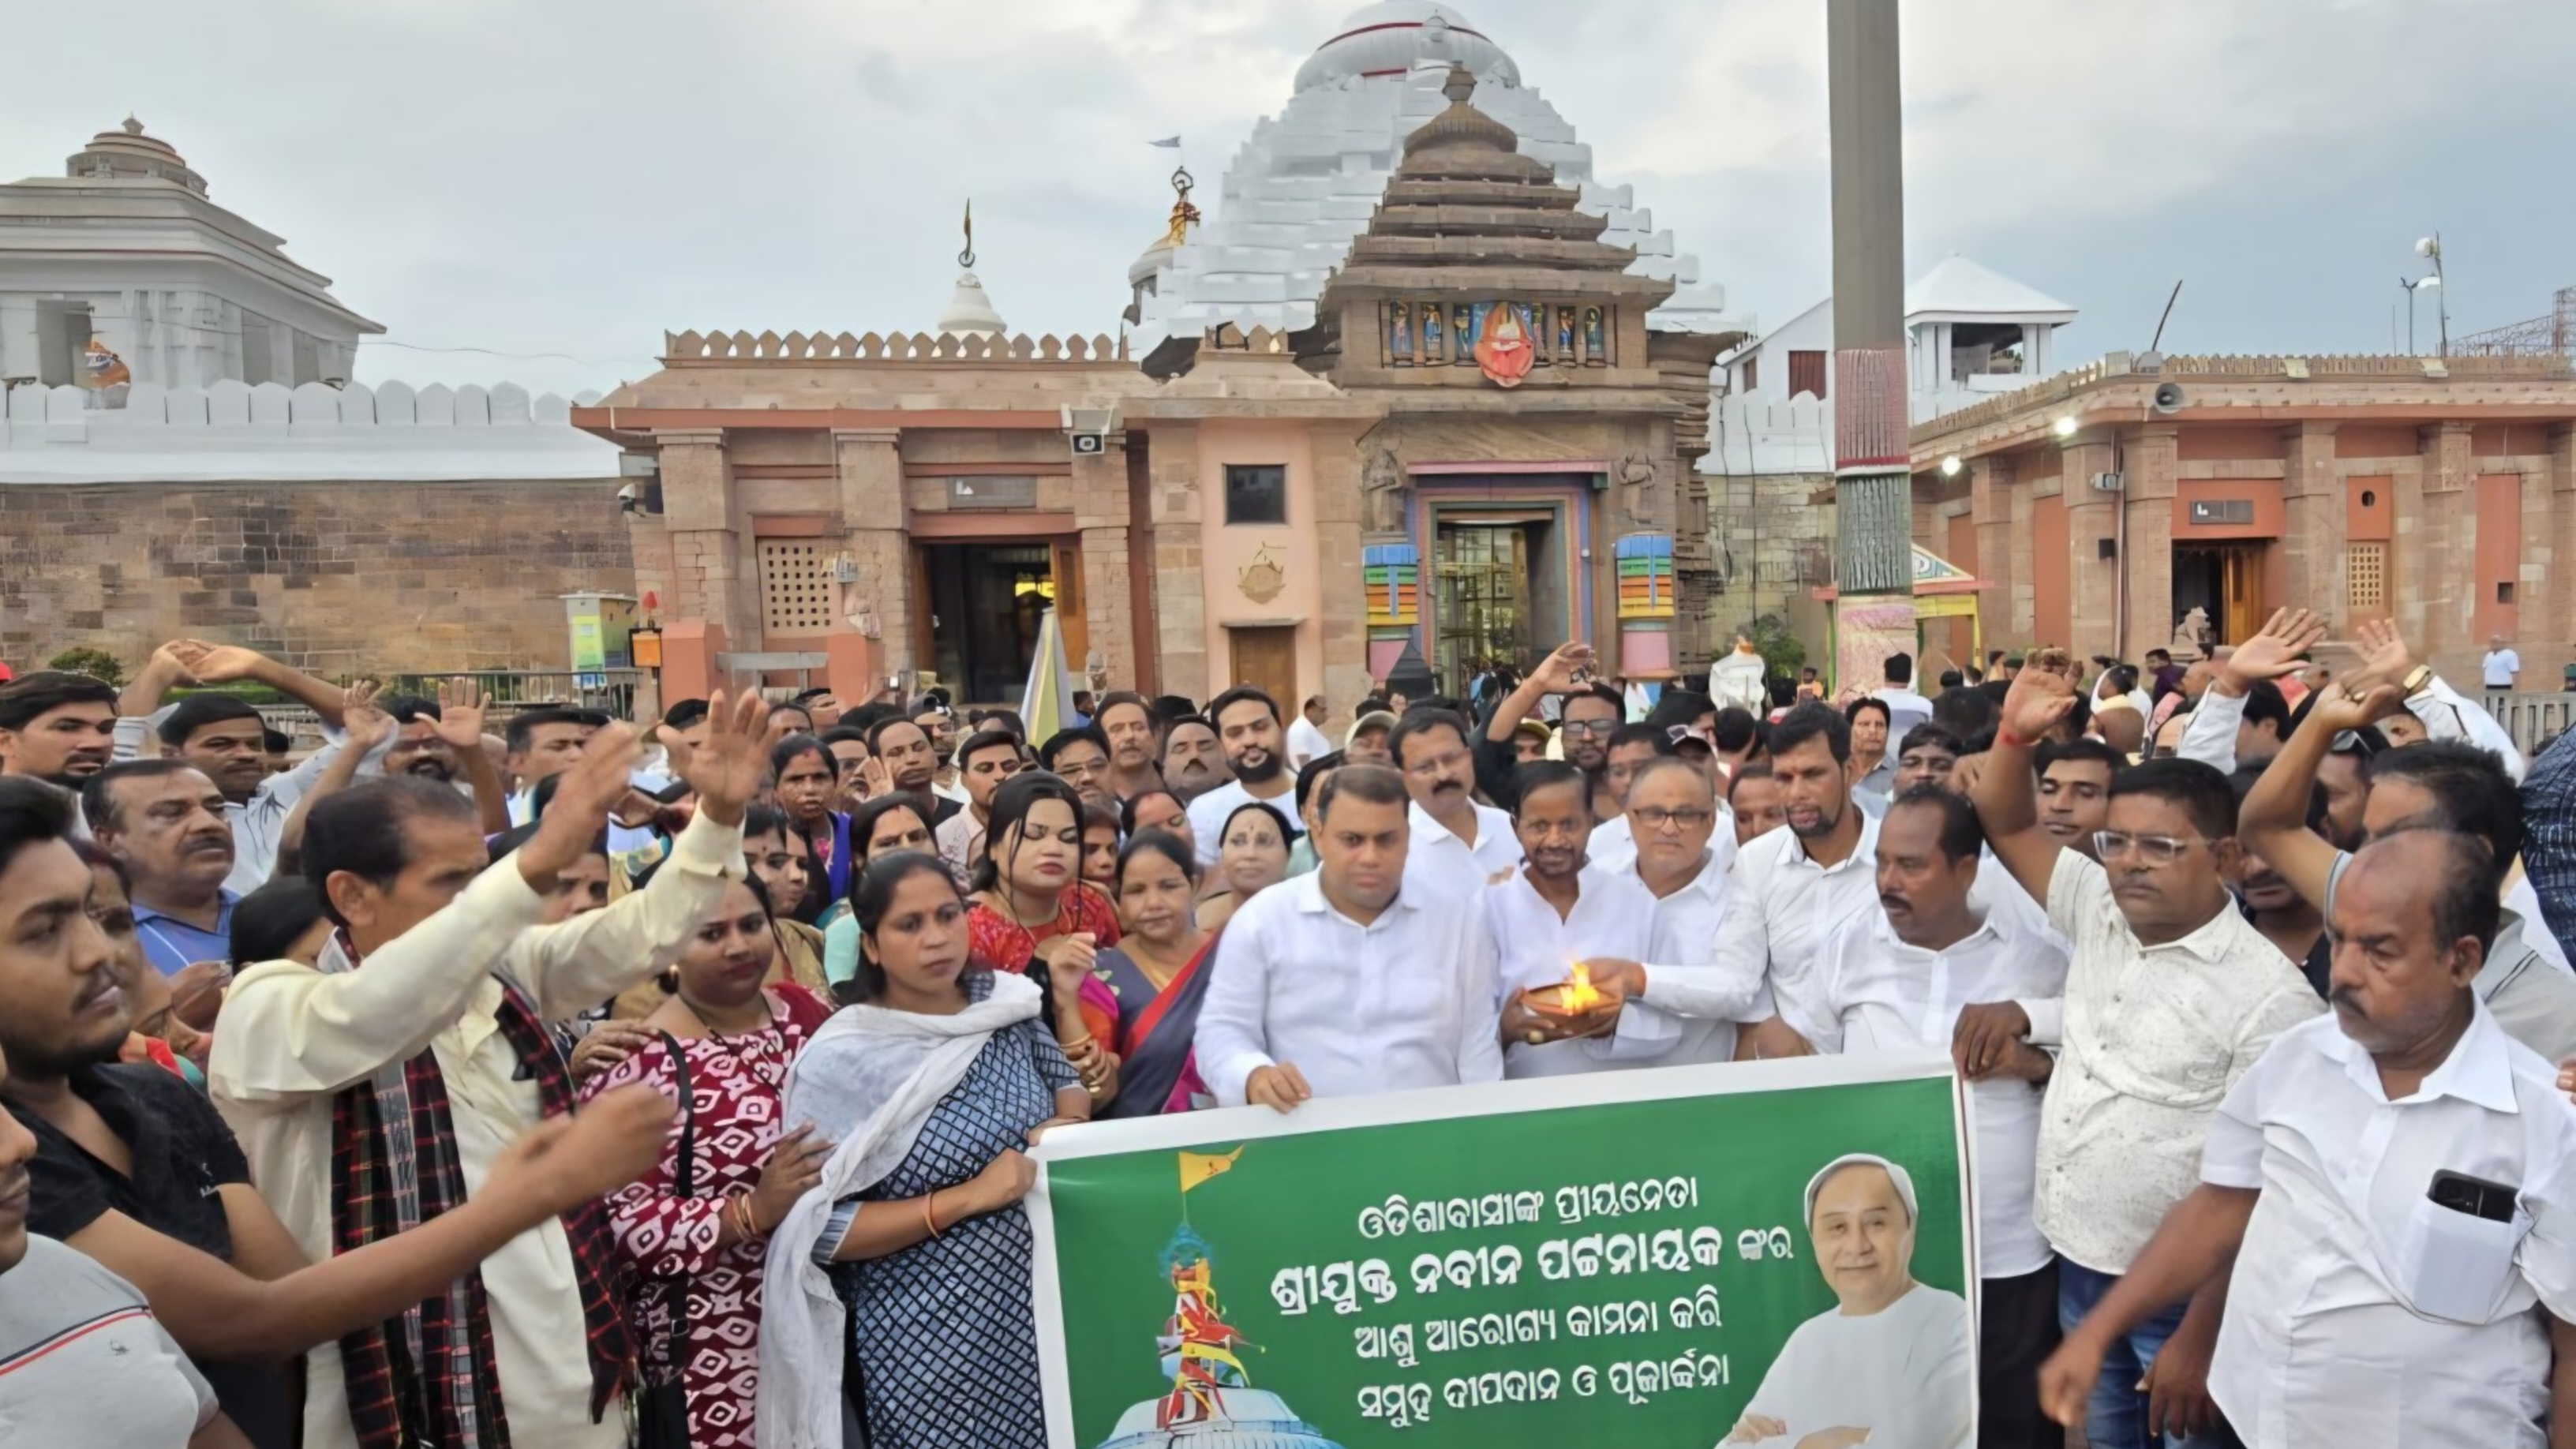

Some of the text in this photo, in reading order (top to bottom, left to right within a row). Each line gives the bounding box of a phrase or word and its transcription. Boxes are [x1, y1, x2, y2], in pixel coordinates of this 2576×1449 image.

[1357, 1175, 1698, 1239] ଓଡିଶାବାସୀଙ୍କ ପ୍ରୀୟନେତା
[1270, 1226, 1794, 1316] ଶ୍ରୀଯୁକ୍ତ ନବୀନ ପଟ୍ଟନାୟକ ଙ୍କର
[1354, 1283, 1722, 1368] ଆଶୁ ଆରୋଗ୍ୟ କାମନା କରି
[1443, 1368, 1561, 1409] ଦୀପଦାନ
[1571, 1365, 1598, 1396] ଓ
[1608, 1348, 1729, 1405] ପୂଜାର୍ଚ୍ଚନା
